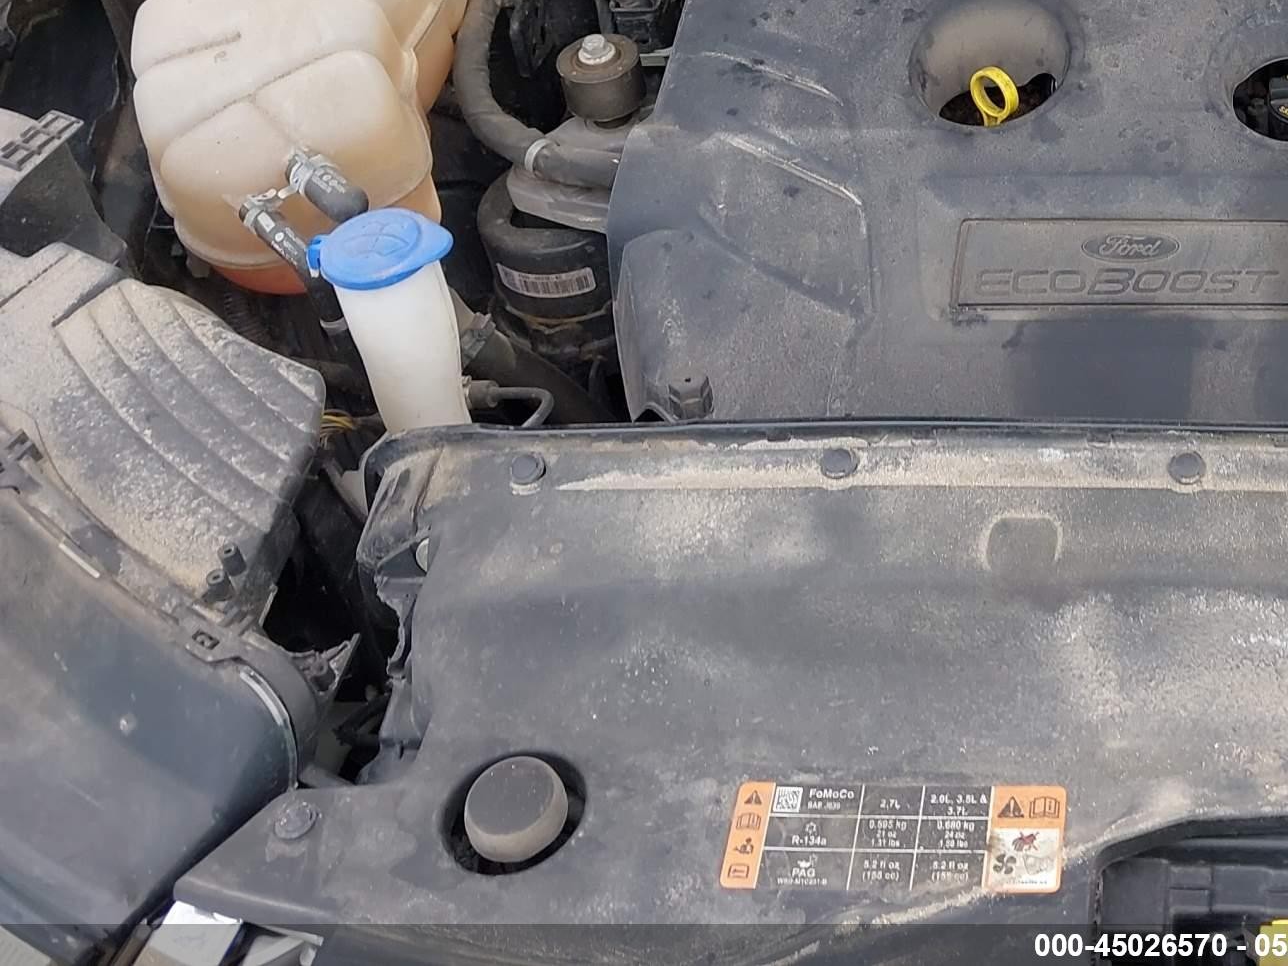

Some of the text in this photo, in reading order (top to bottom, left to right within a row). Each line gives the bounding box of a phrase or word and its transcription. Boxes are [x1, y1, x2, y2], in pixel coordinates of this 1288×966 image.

[1099, 235, 1161, 258] Ford
[975, 268, 1280, 296] ECOBOOST
[809, 788, 855, 799] FoMoCo
[792, 835, 827, 846] R-134a
